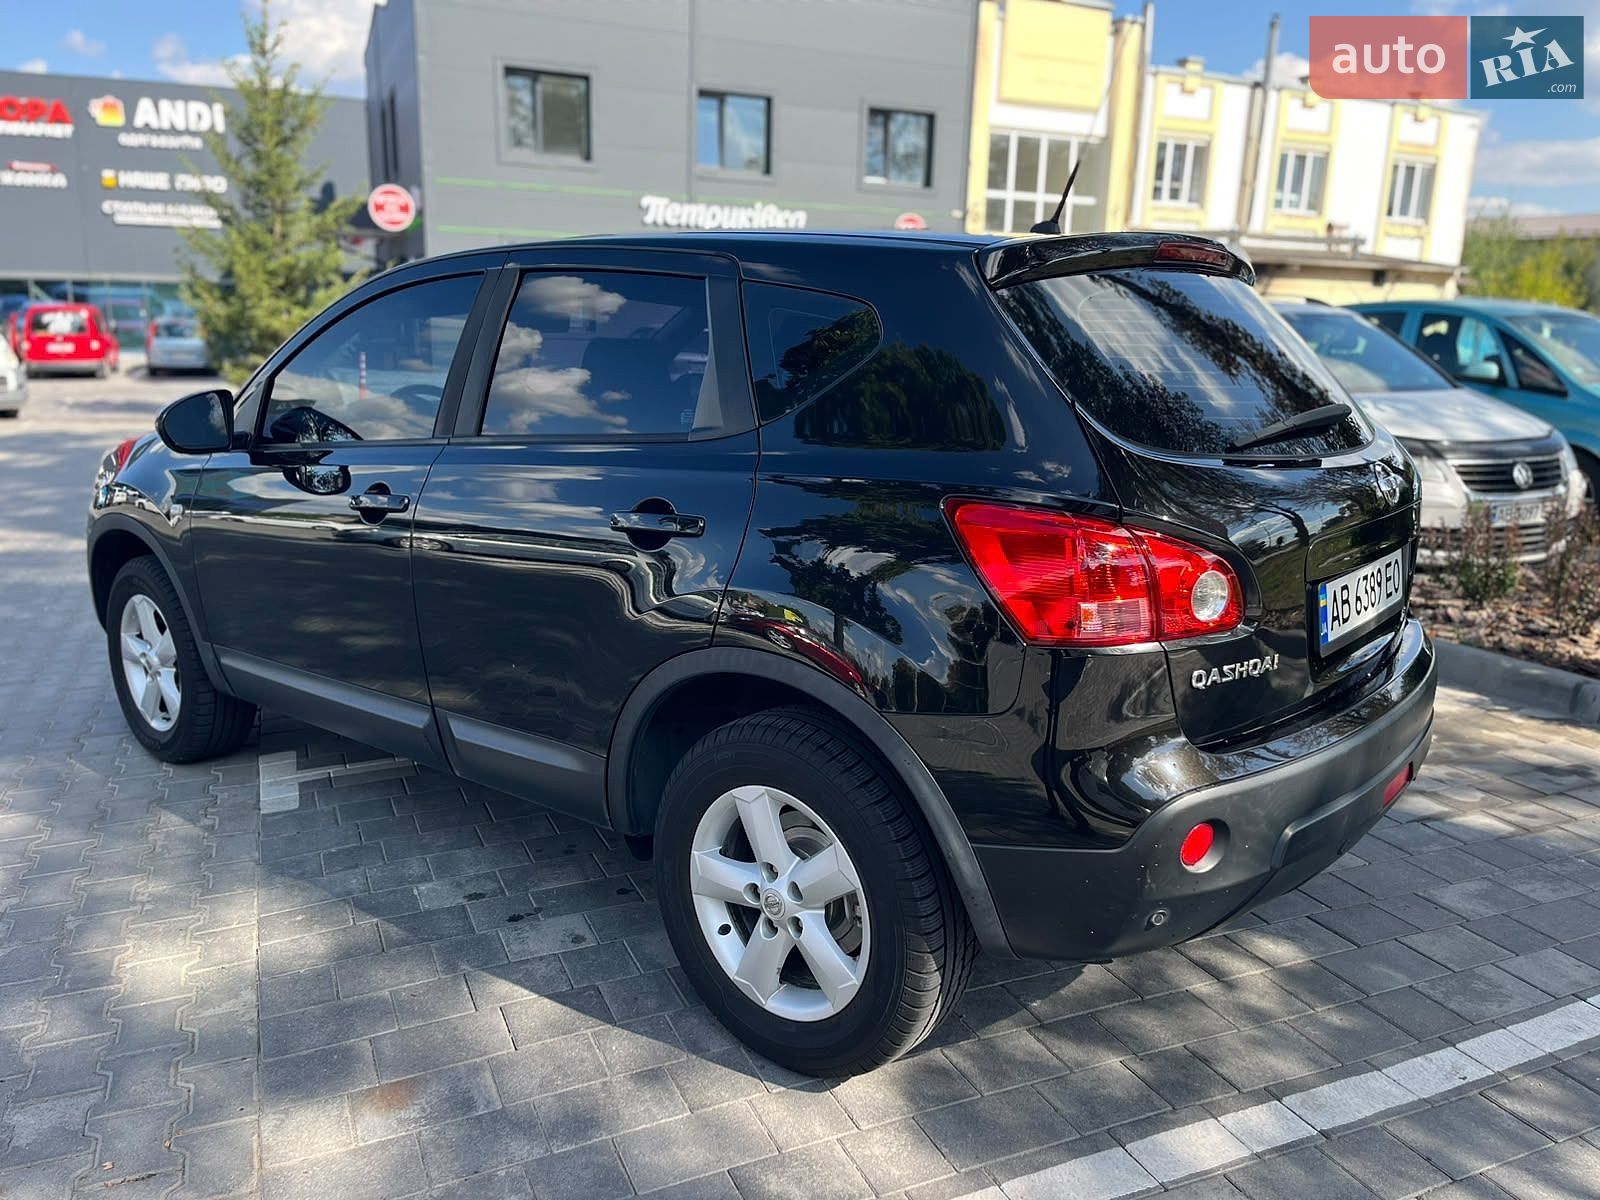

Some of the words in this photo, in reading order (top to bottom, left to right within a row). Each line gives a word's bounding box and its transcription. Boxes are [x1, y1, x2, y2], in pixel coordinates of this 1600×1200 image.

[133, 97, 226, 134] ANDI
[1330, 584, 1351, 632] AB
[1354, 566, 1383, 617] 6389
[1191, 654, 1280, 690] QASHQAI
